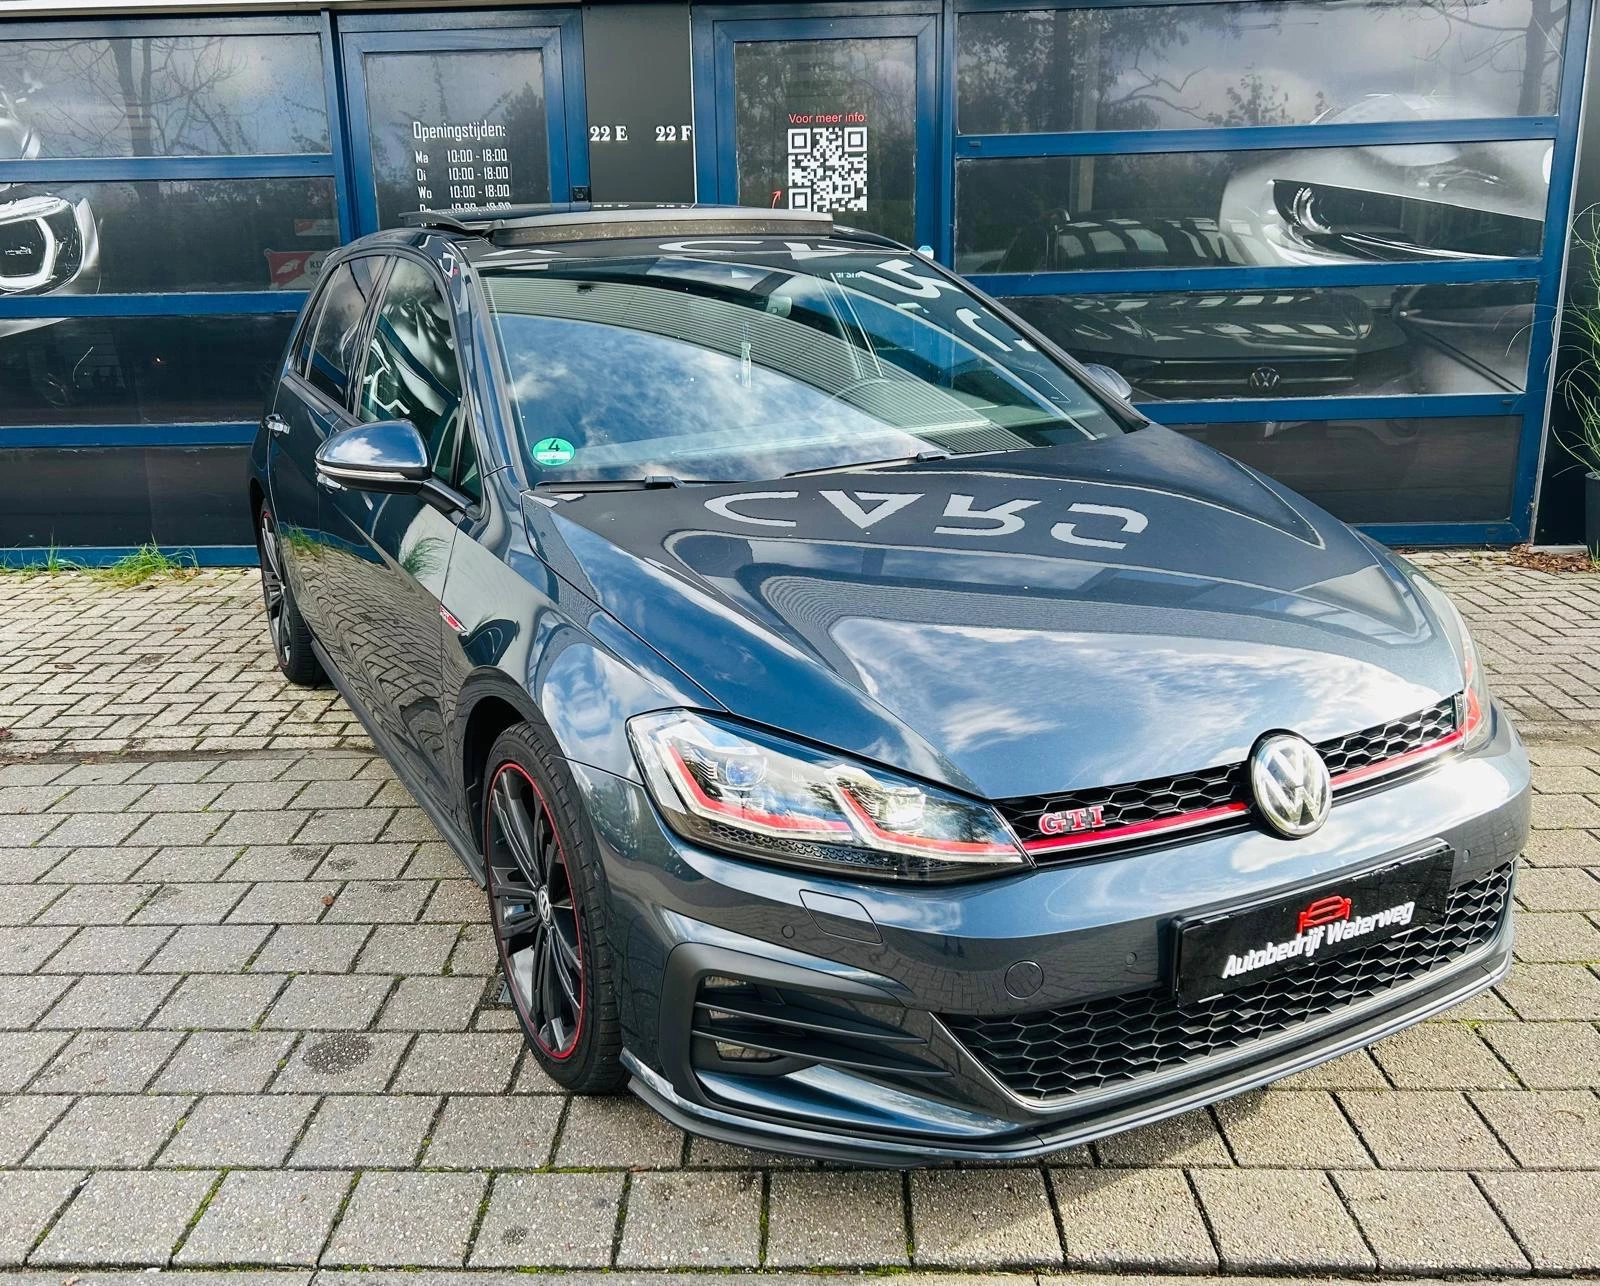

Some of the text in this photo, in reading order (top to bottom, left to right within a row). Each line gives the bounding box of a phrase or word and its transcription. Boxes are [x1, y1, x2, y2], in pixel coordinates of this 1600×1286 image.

[788, 111, 868, 124] Voor meer info:
[412, 119, 506, 142] Openingstijden:
[589, 125, 628, 142] 22 E
[655, 125, 692, 142] 22 F
[415, 150, 429, 164] Ma
[447, 149, 473, 163] 10:00
[482, 148, 508, 162] 18:00
[416, 168, 427, 182] Di
[448, 167, 474, 180] 10:00
[483, 166, 509, 180] 18:00
[417, 186, 433, 199] Wo
[449, 185, 475, 198] 10:00
[485, 184, 510, 197] 18:00
[548, 439, 561, 452] 4
[1039, 805, 1106, 835] GTI
[1221, 901, 1416, 979] Autobedrijf Waterweg
